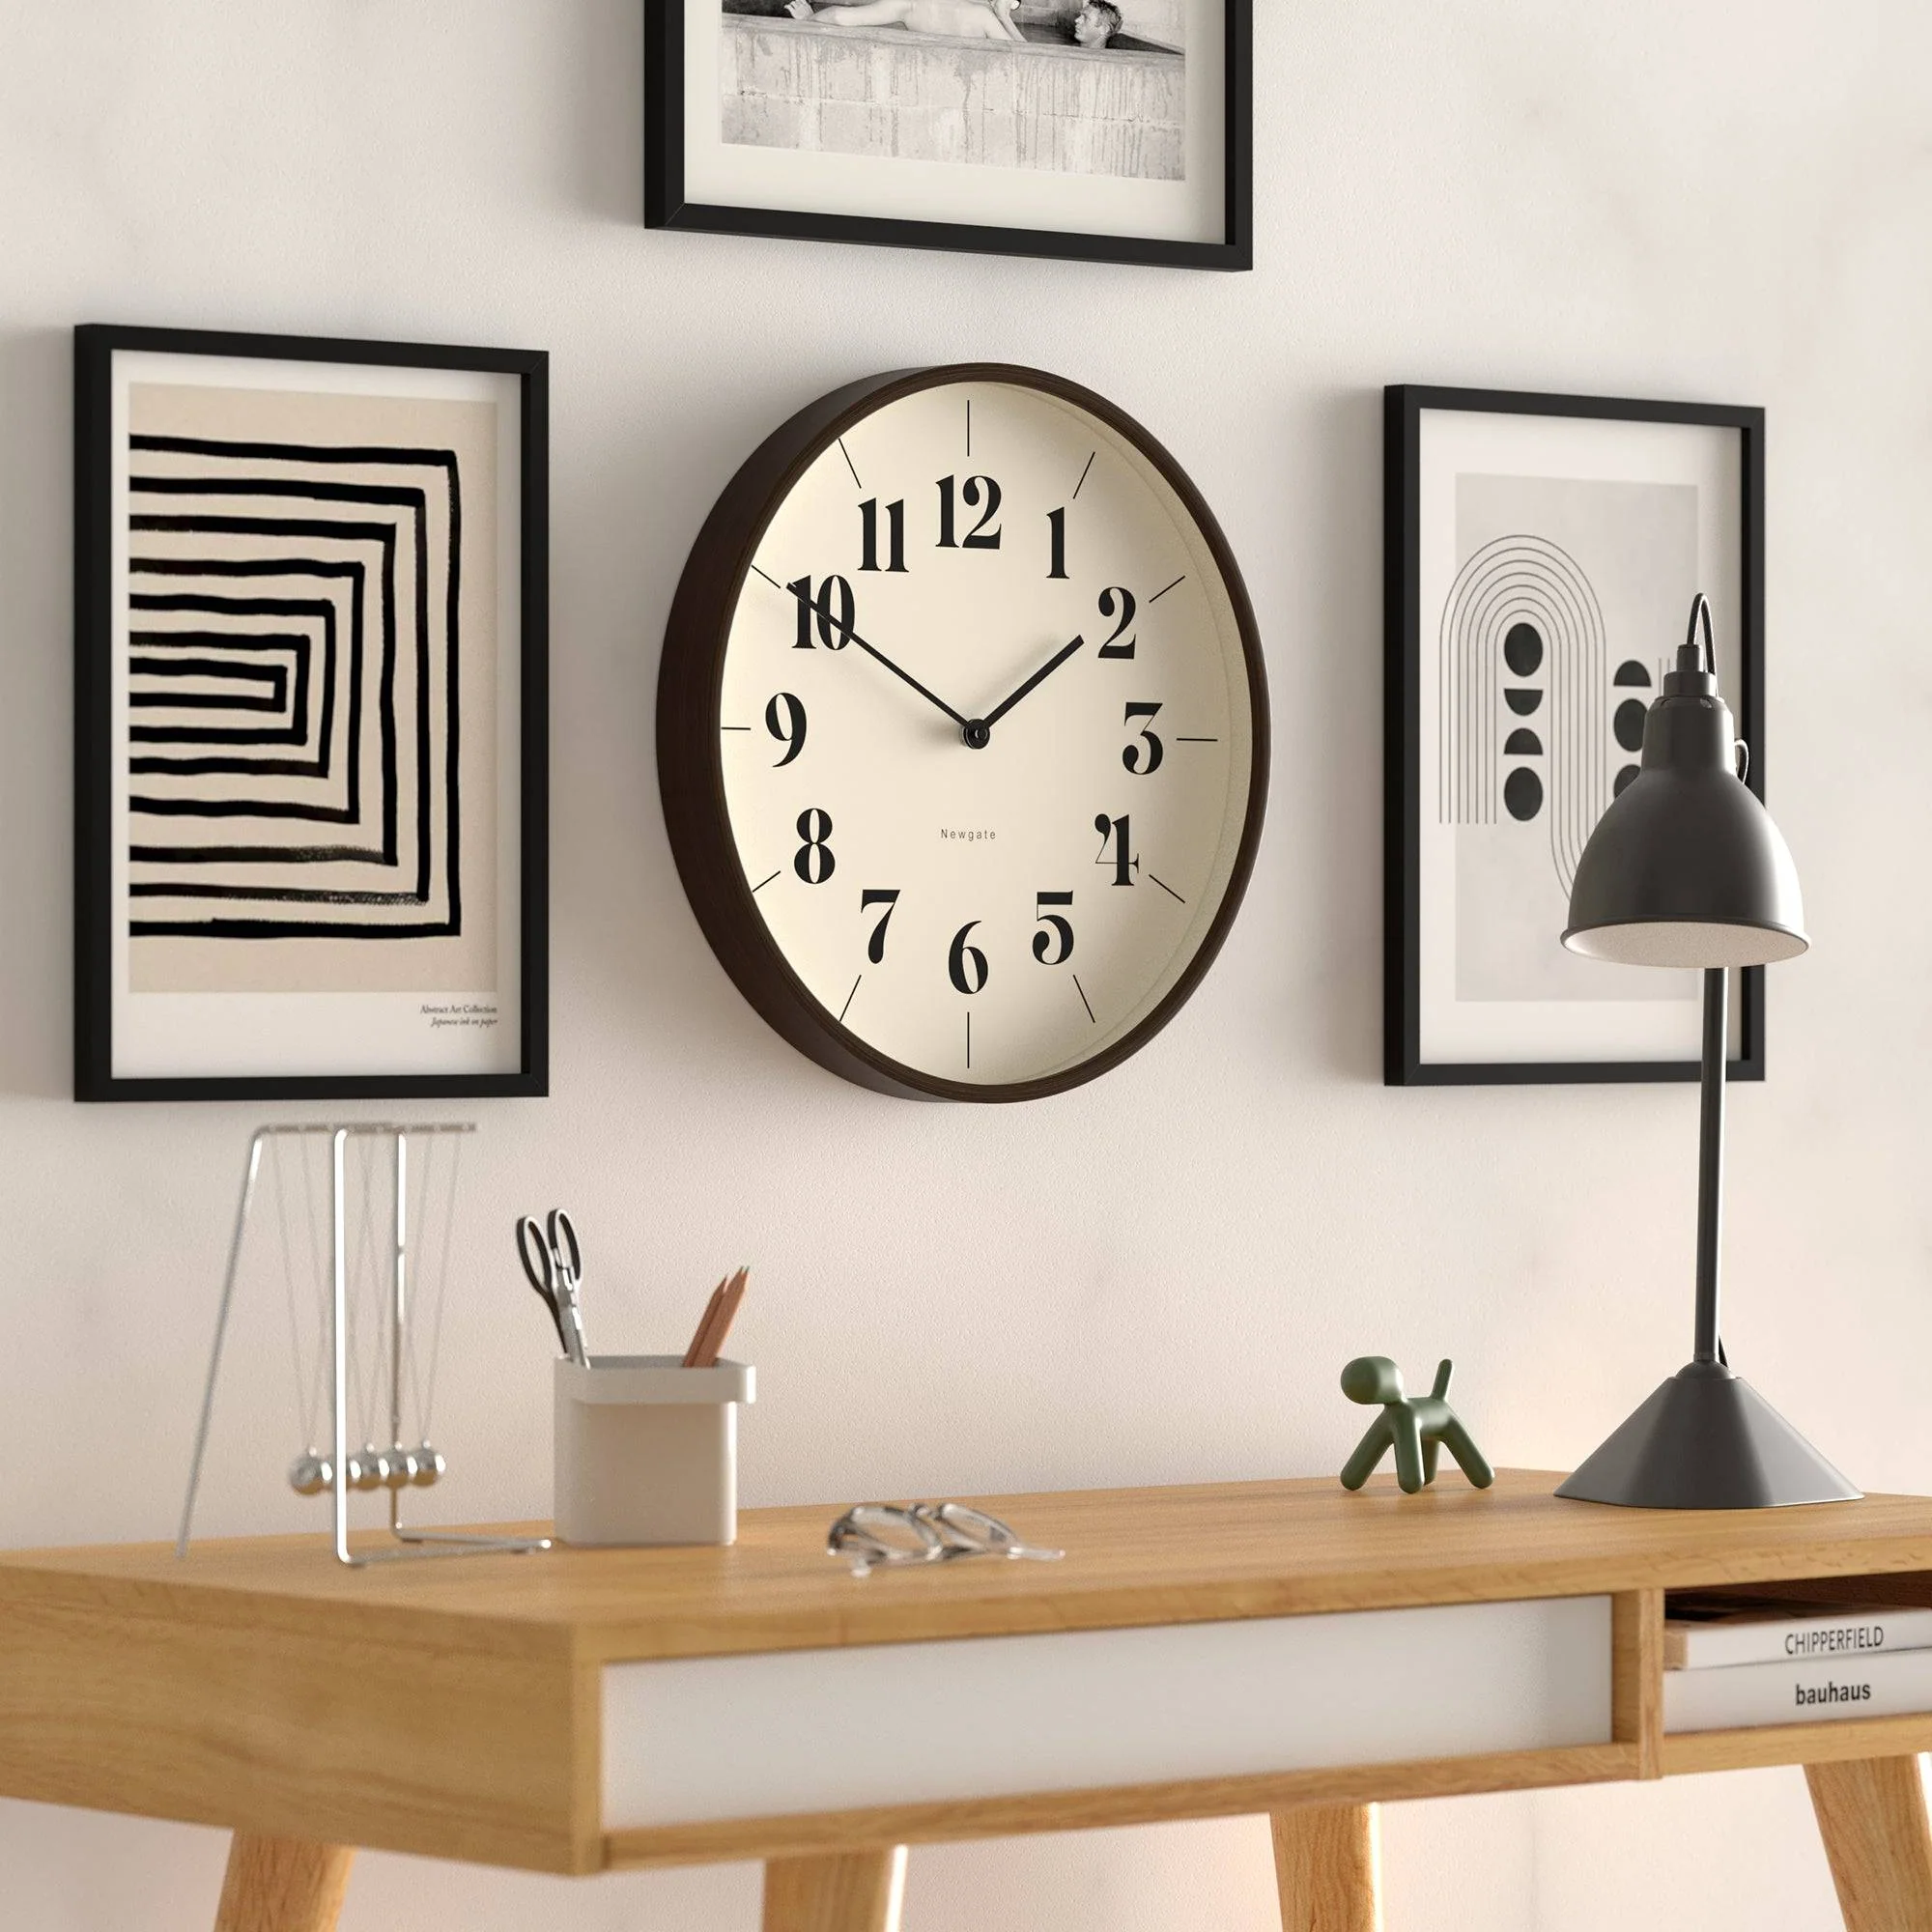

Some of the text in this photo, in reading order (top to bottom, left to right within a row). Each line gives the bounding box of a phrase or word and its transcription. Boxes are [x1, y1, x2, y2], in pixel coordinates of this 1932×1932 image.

[857, 497, 910, 573] 11
[935, 474, 1002, 551] 12
[1045, 506, 1070, 580] 1
[791, 574, 856, 651] 10
[1097, 586, 1137, 660] 2
[765, 692, 808, 768] 9
[1122, 701, 1164, 776] 3
[793, 808, 836, 885] 8
[940, 828, 997, 842] Newgate
[1094, 813, 1141, 887] 4
[860, 889, 901, 965] 7
[948, 920, 989, 995] 6
[1032, 890, 1075, 966] 5
[449, 1004, 462, 1014] Art
[1784, 1626, 1884, 1655] CHIPPERFIELD
[1795, 1681, 1871, 1706] bauhaus
